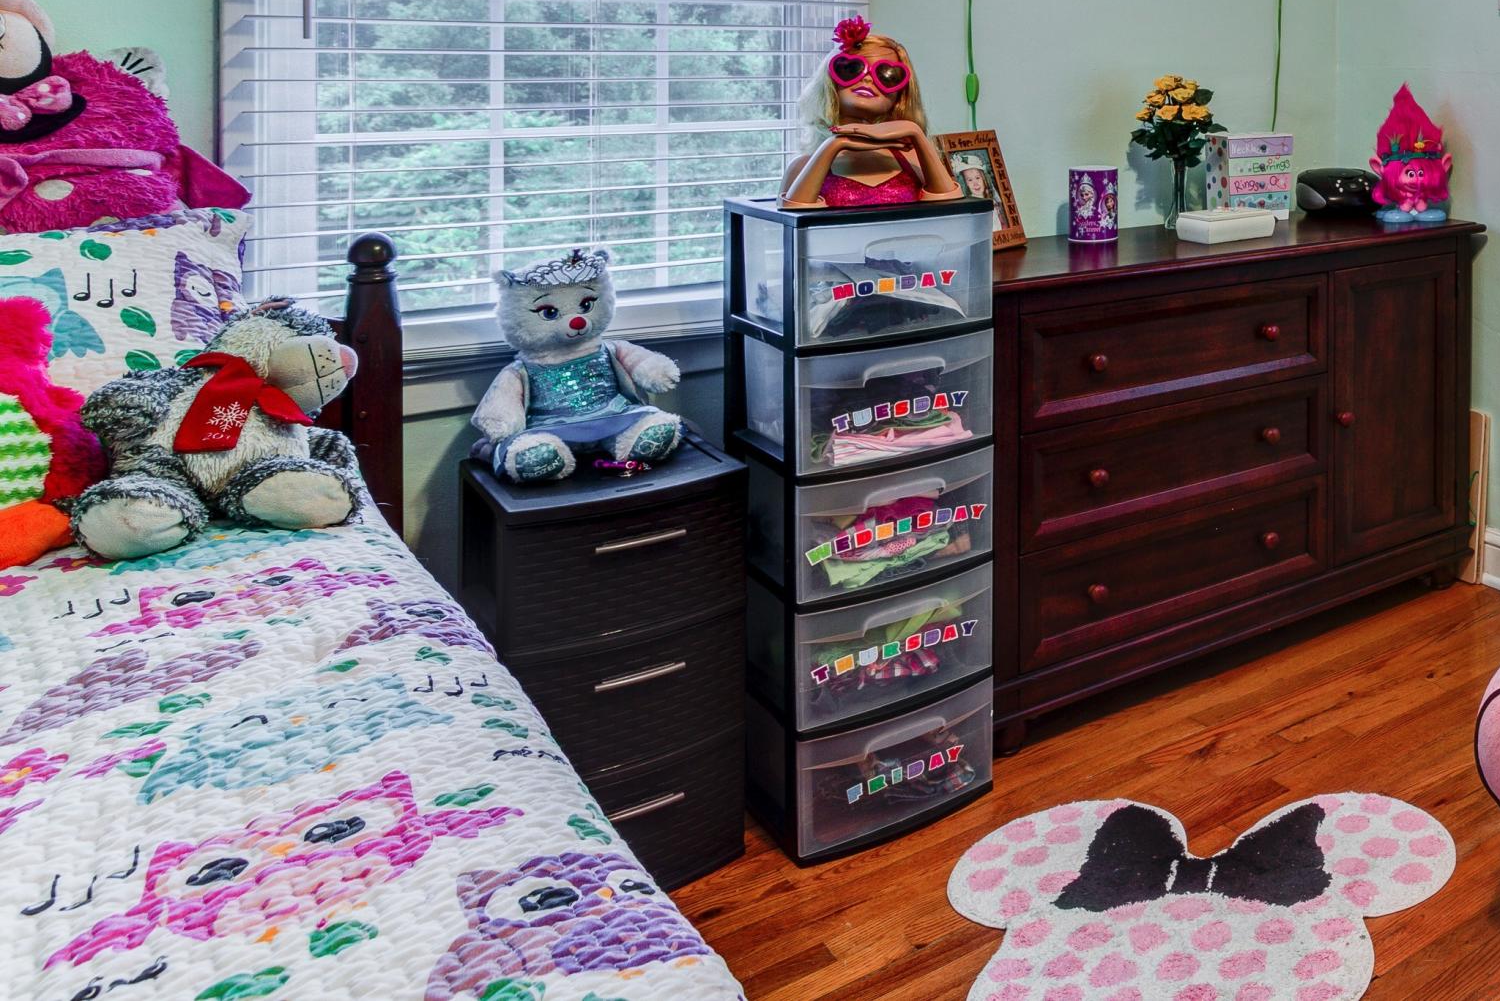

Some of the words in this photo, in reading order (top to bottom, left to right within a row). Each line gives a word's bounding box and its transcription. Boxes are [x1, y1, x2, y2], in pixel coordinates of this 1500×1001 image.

[832, 270, 957, 301] MONDAY
[832, 391, 968, 433] TUESDAY
[523, 459, 560, 479] FROZEN
[805, 504, 987, 566] WEDNESDAY
[811, 620, 978, 684] THURSDAY
[847, 745, 964, 804] FRIDAY
